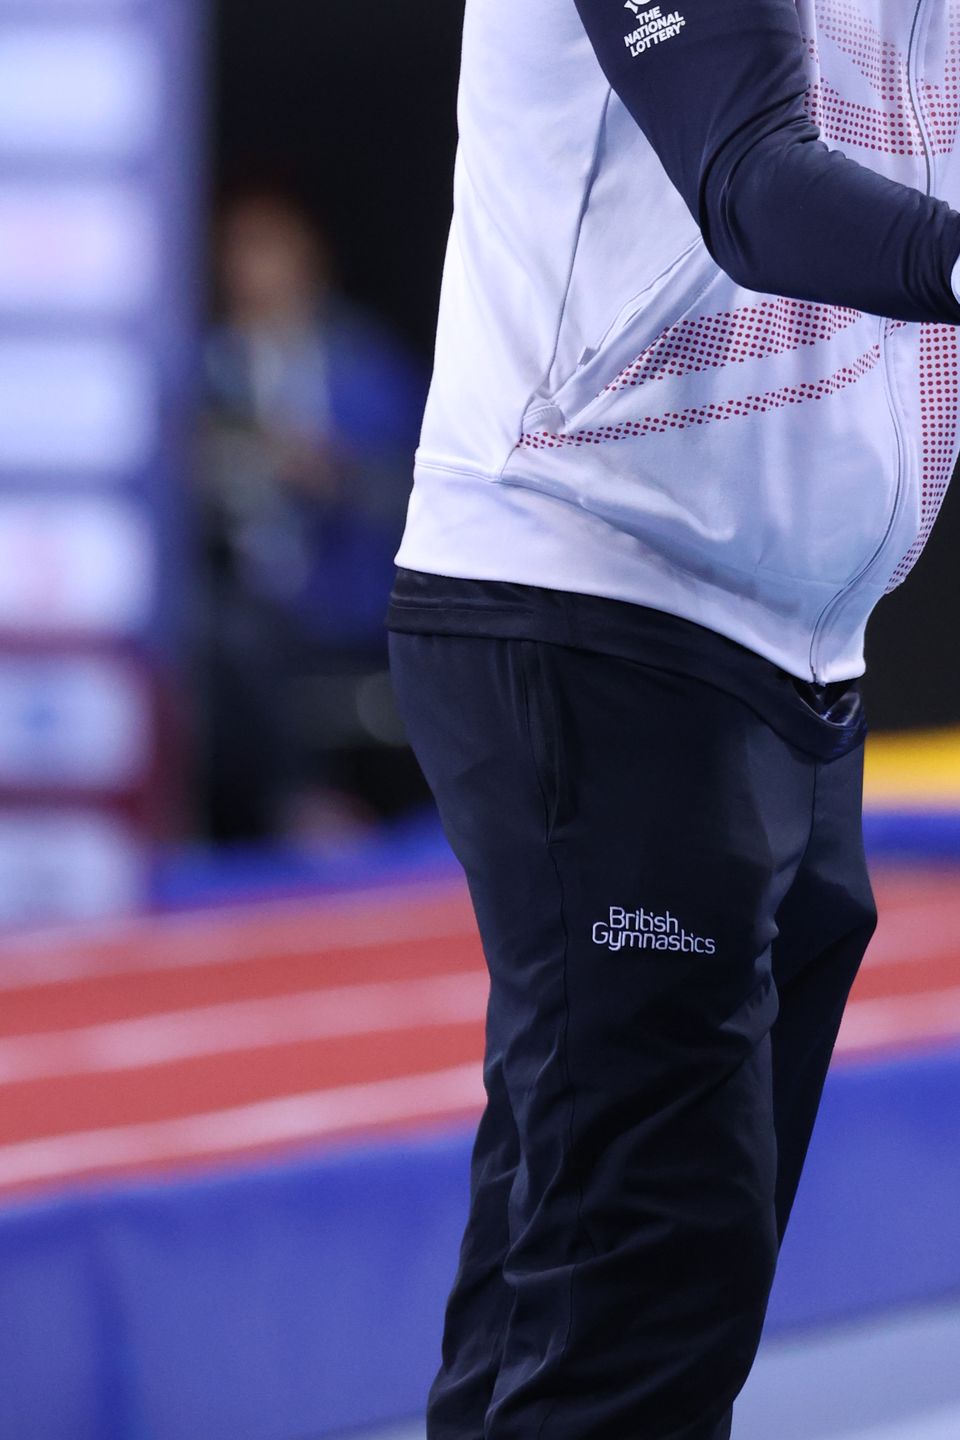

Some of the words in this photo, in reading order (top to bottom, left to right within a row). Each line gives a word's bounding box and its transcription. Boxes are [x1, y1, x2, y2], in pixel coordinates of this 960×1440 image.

[623, 11, 684, 48] NATIONAL
[635, 5, 662, 25] THE
[609, 906, 678, 934] British
[592, 921, 716, 954] Gymnastics
